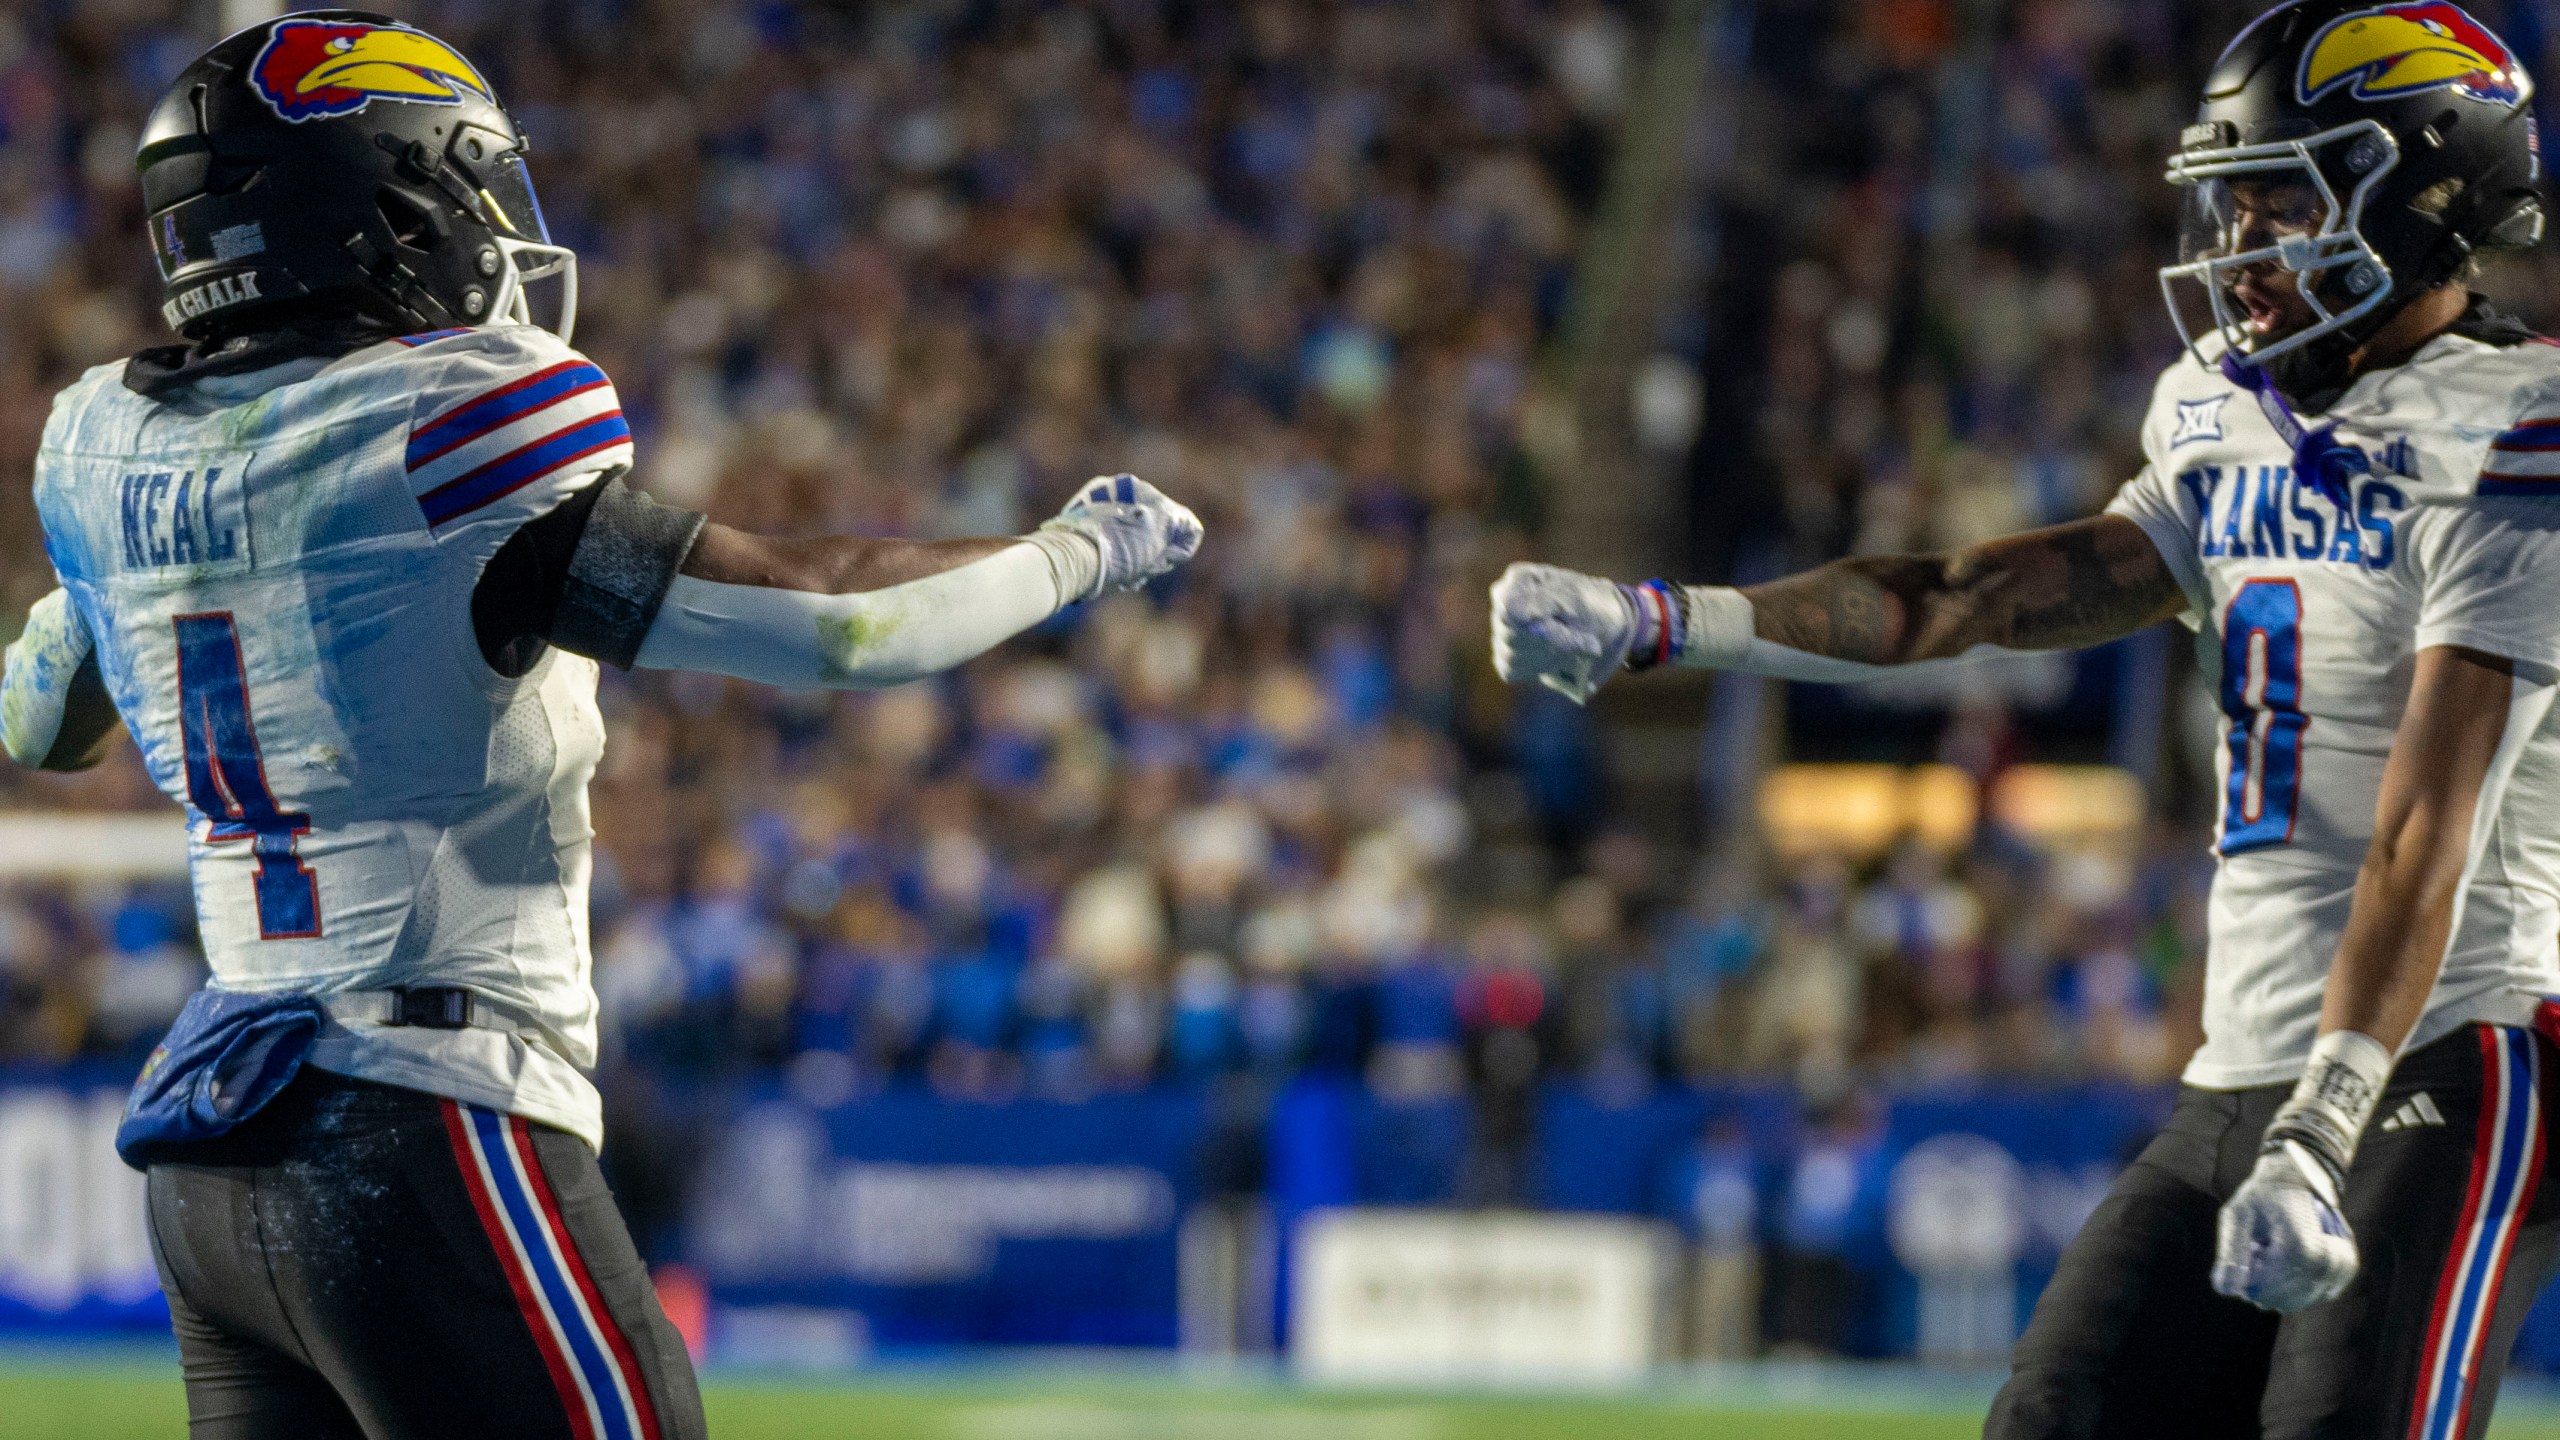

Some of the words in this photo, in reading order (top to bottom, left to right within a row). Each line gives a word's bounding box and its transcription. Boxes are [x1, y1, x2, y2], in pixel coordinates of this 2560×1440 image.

[179, 270, 262, 318] CHALK
[121, 467, 237, 568] NEAL
[172, 610, 323, 940] 4
[2218, 576, 2311, 858] 0
